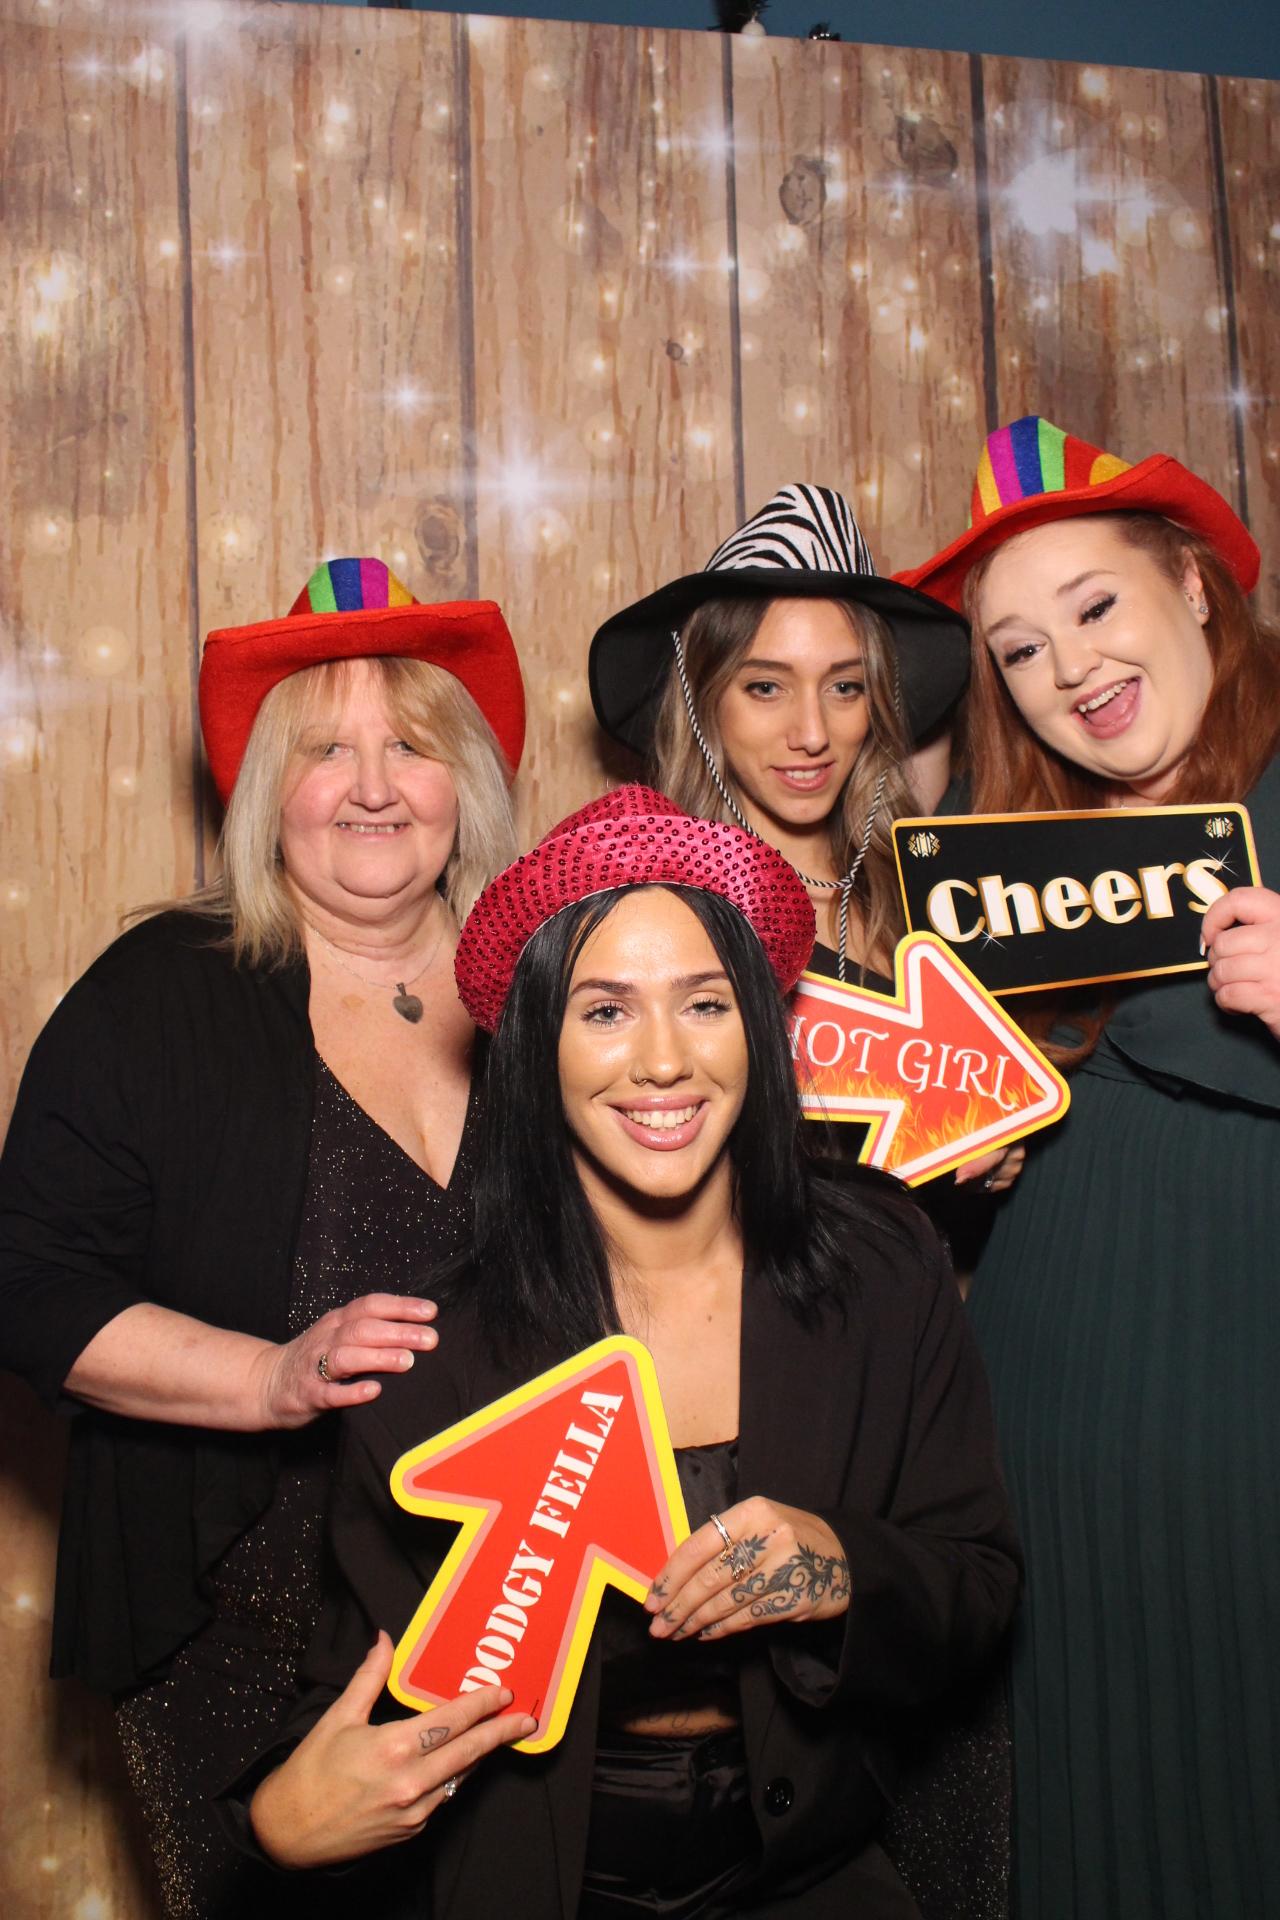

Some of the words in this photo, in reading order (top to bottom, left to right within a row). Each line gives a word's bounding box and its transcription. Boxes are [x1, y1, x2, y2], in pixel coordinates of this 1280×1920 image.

[926, 858, 1229, 943] Cheers
[896, 1038, 1017, 1111] GIRL
[459, 1538, 555, 1694] DODGY
[529, 1390, 624, 1539] FELLA
